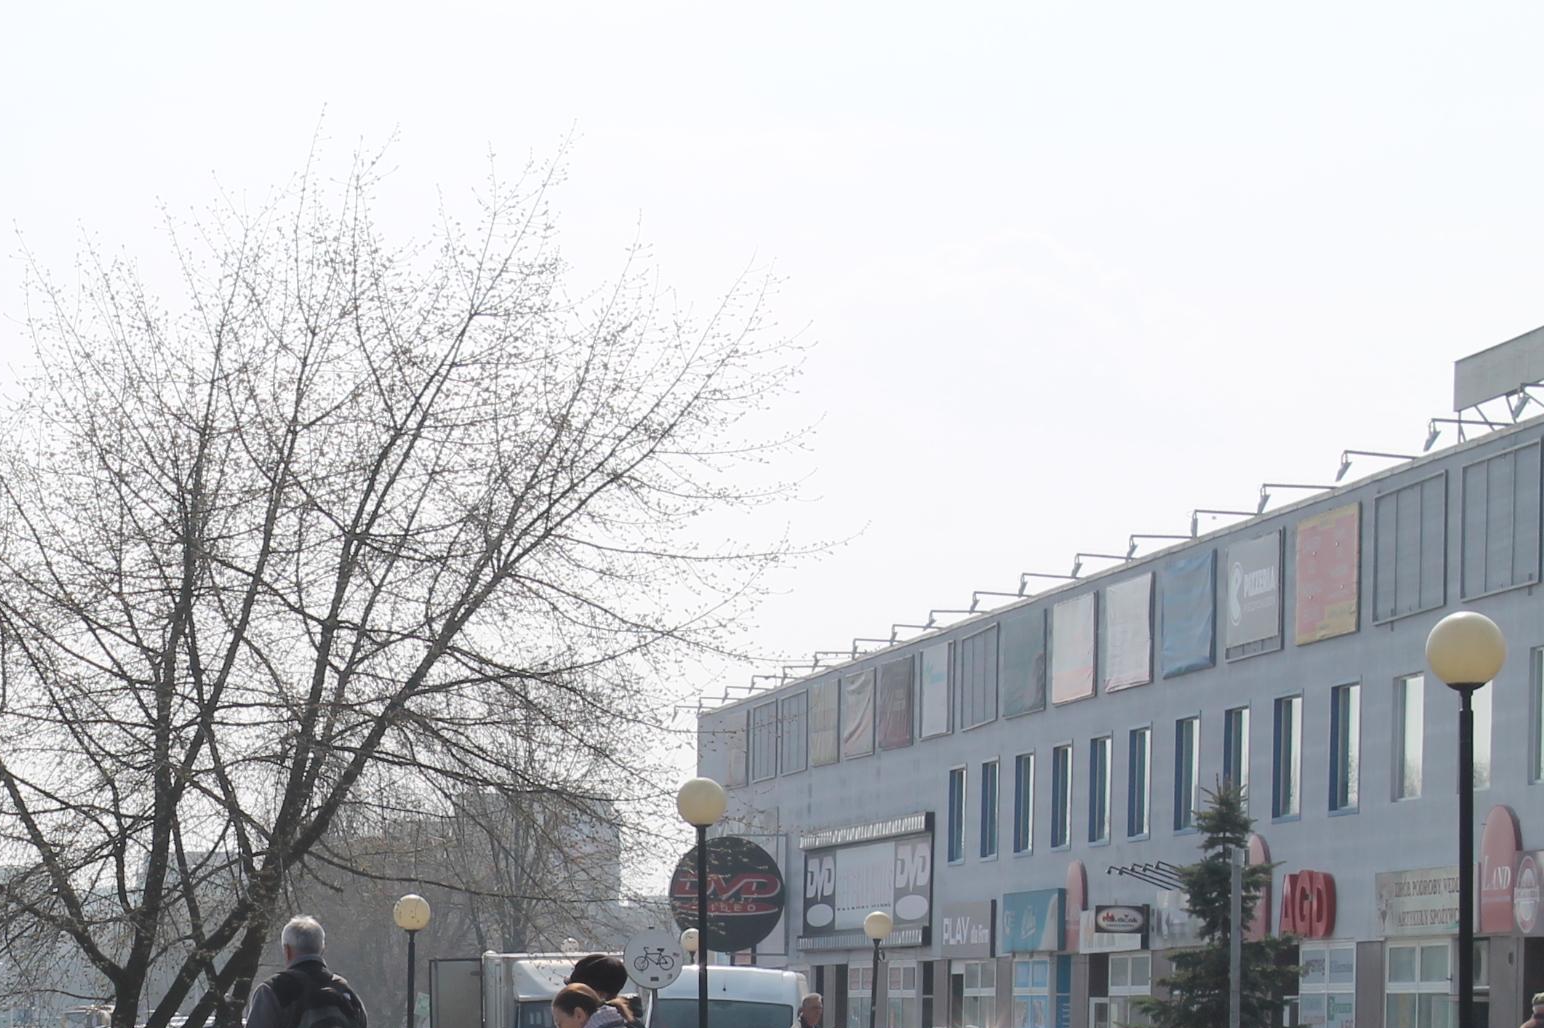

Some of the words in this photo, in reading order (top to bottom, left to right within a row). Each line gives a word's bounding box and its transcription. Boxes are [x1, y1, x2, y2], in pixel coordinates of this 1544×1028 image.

[673, 871, 781, 901] DVD
[805, 855, 836, 903] DVD
[895, 842, 932, 893] DVD
[1279, 870, 1335, 939] AGD
[942, 917, 970, 945] PLAY
